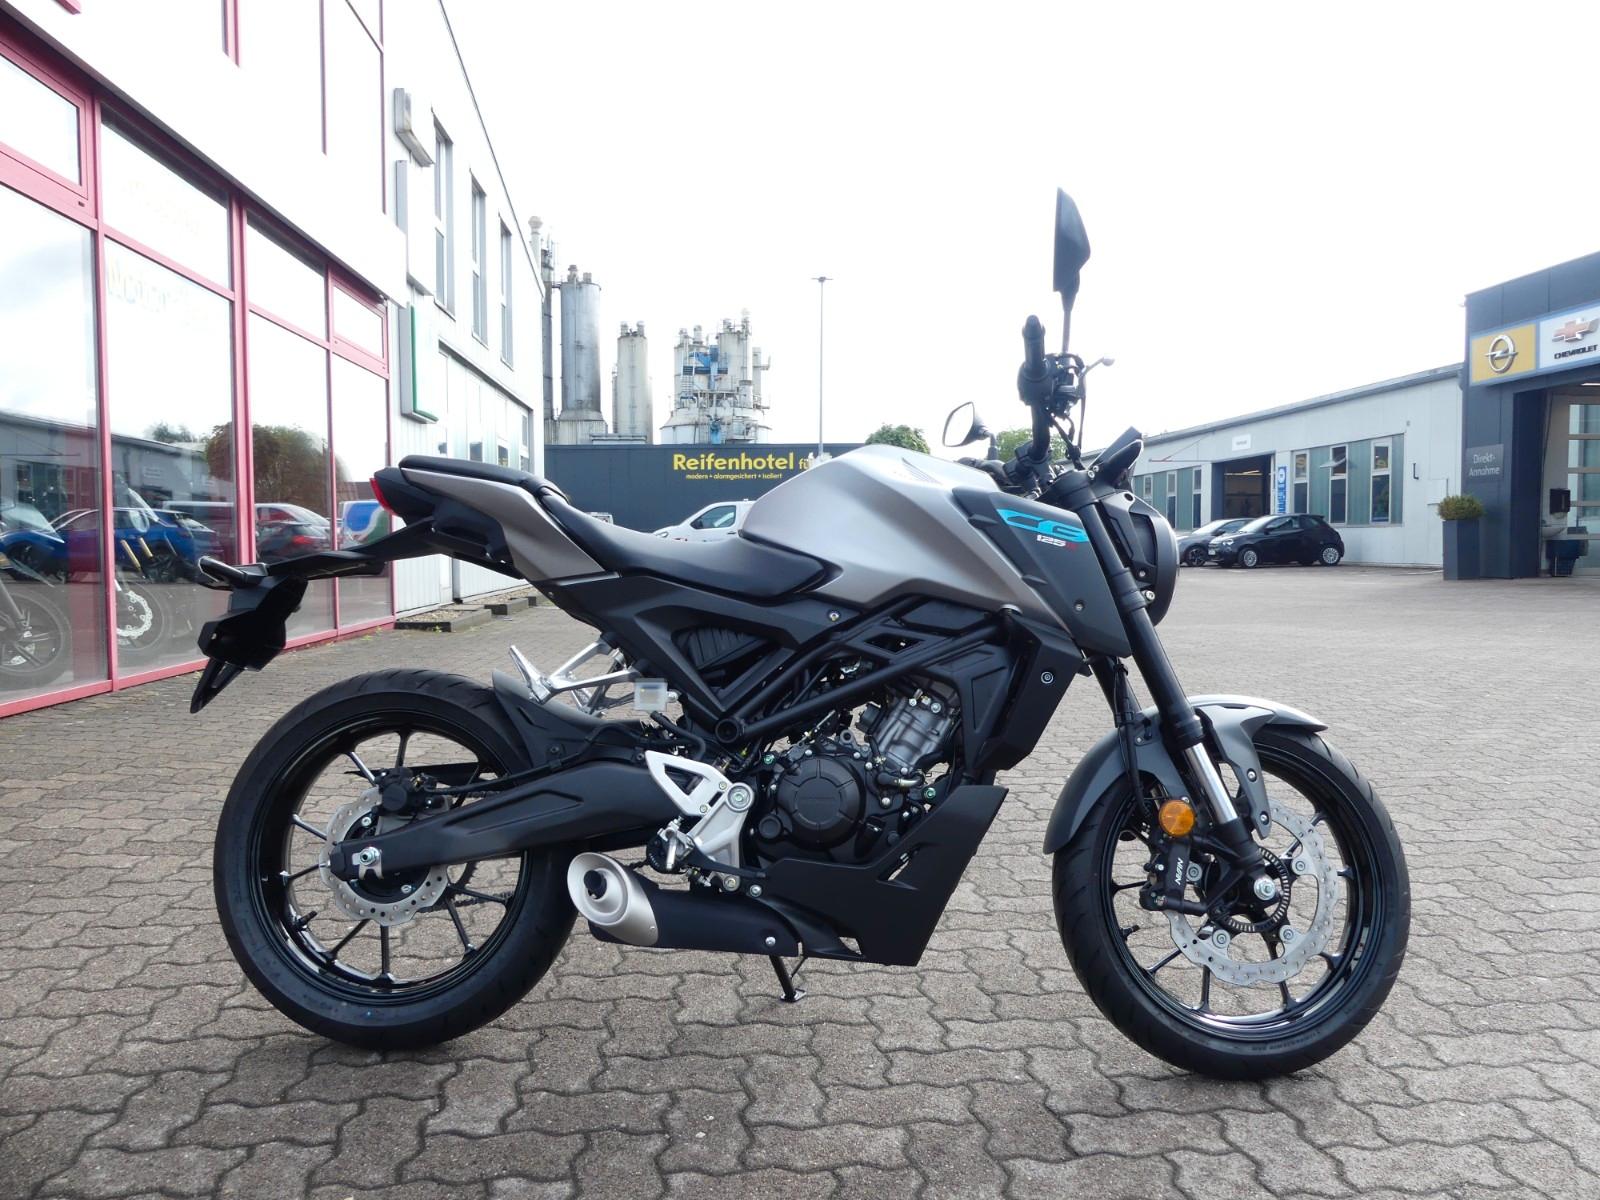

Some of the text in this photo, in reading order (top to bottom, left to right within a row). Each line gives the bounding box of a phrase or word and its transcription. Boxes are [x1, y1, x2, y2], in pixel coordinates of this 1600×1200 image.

[1553, 344, 1598, 360] CHEVROLET
[673, 452, 794, 470] Reifenhotel
[1473, 453, 1496, 464] Direkt-
[1469, 465, 1500, 477] Annahme
